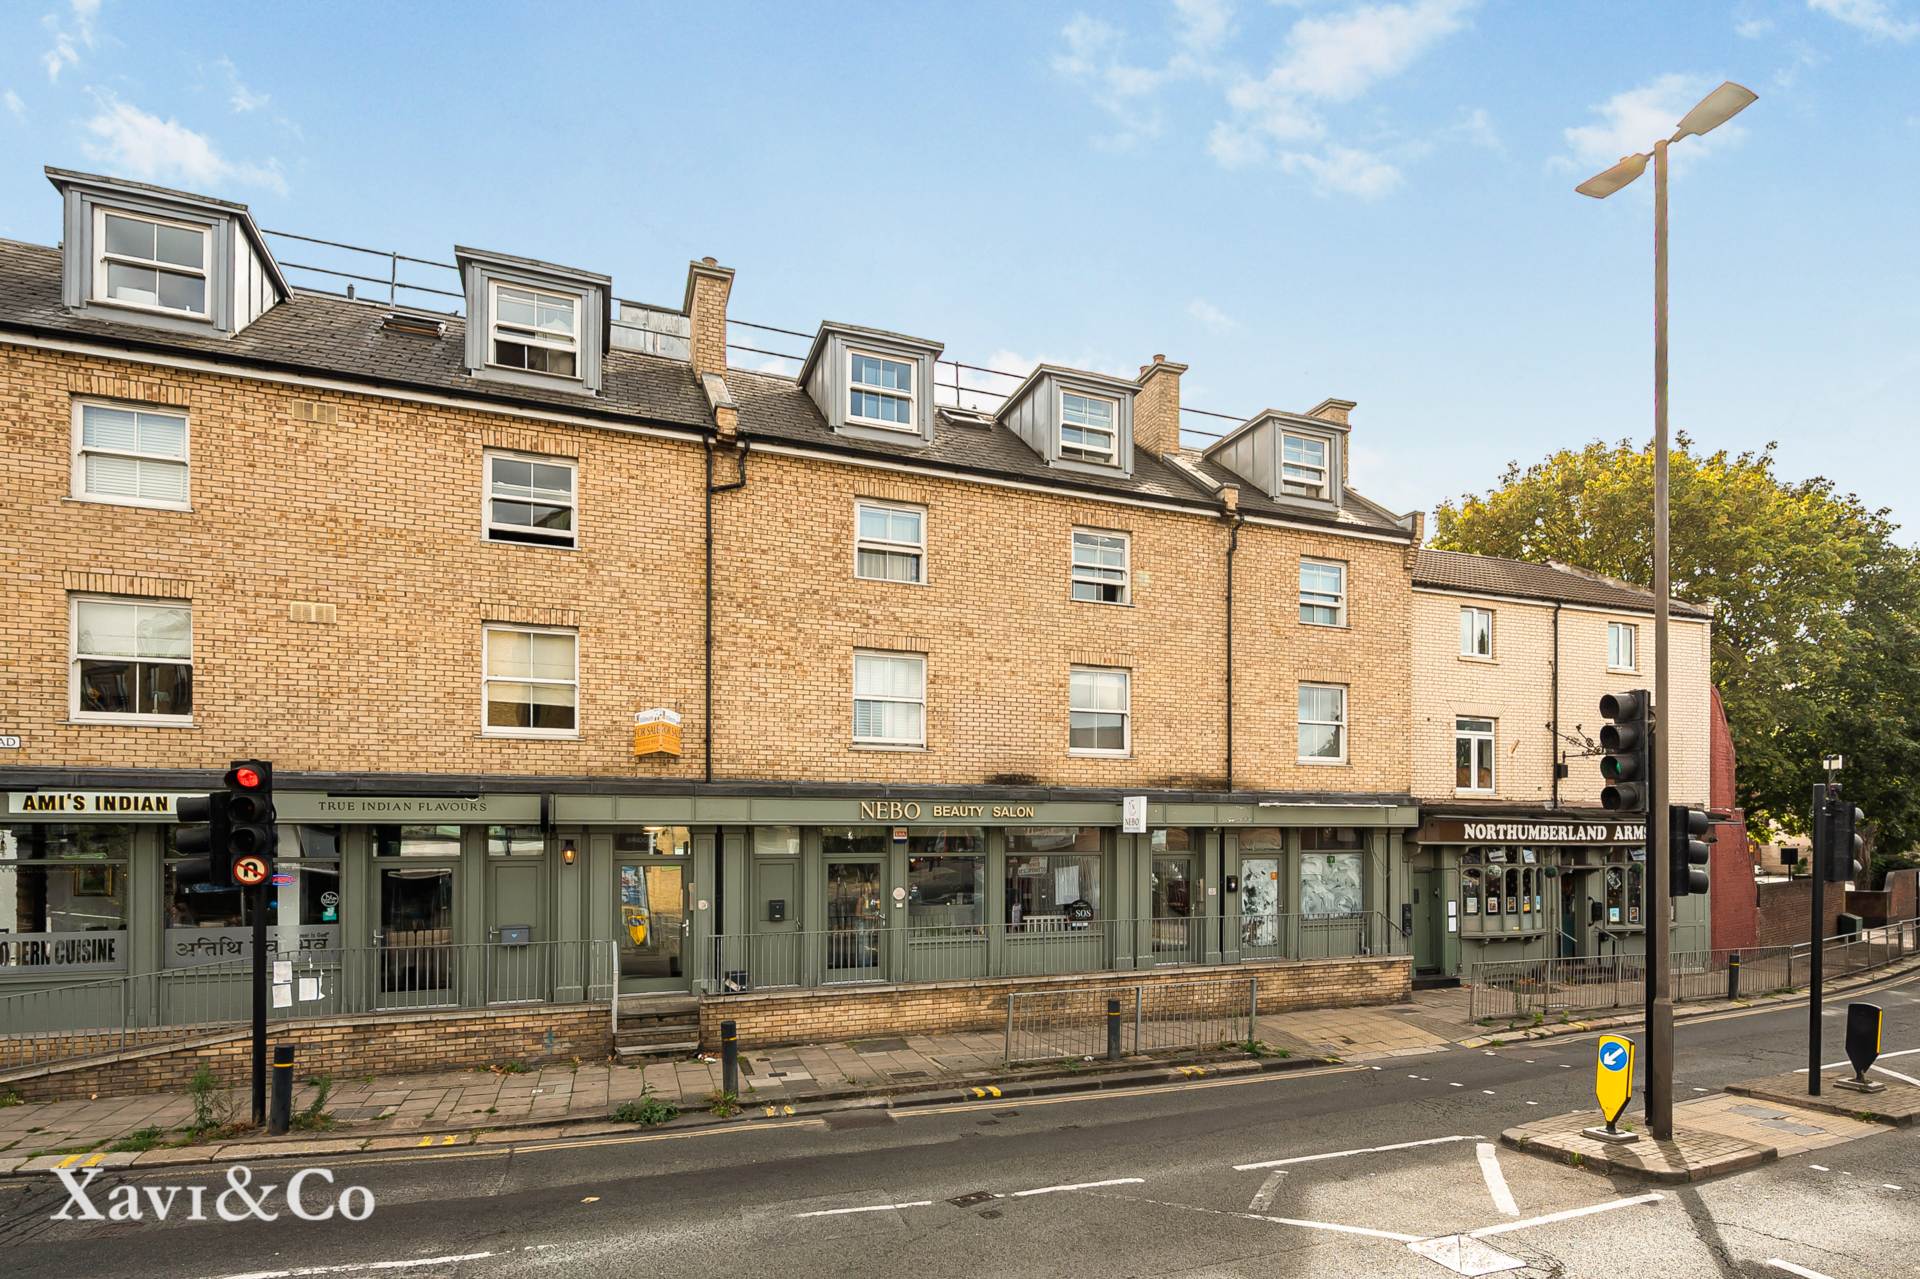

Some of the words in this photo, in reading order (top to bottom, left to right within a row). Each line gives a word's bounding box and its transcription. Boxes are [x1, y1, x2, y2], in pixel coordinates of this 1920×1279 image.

[23, 793, 85, 811] AMI'S
[95, 795, 169, 812] INDIAN
[318, 801, 355, 811] TRUE
[362, 801, 412, 812] INDIAN
[418, 802, 487, 812] FLAVOURS
[860, 801, 921, 820] NEBO
[933, 805, 984, 817] BEAUTY
[992, 806, 1034, 818] SALON
[1463, 823, 1607, 841] NORTHUMBERLAND
[1614, 825, 1647, 841] ARM
[54, 938, 116, 965] CUISINE
